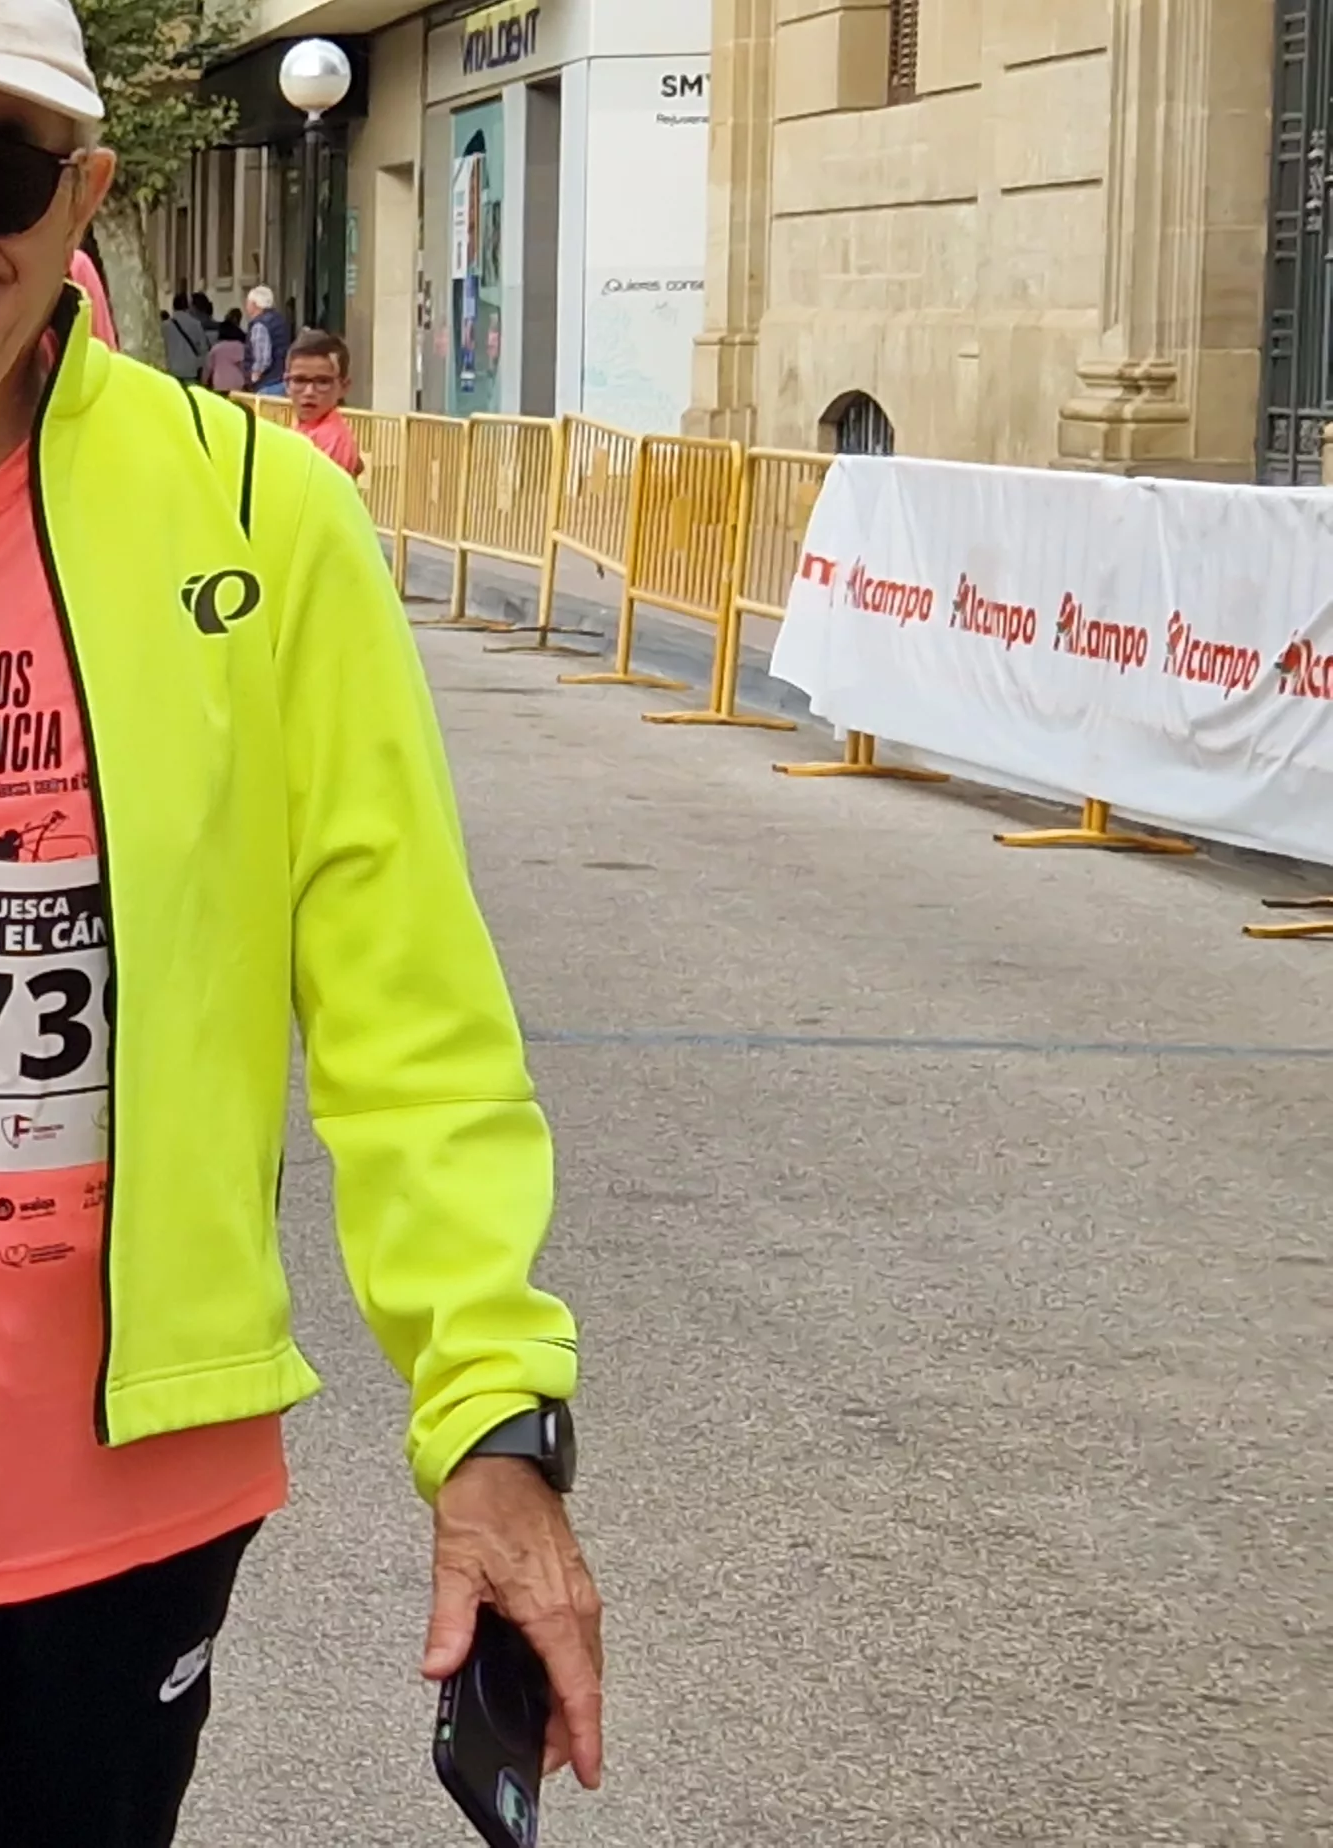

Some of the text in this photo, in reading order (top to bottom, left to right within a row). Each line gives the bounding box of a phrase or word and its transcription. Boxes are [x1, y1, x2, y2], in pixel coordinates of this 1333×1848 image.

[1053, 592, 1148, 675] Alampo
[1163, 609, 1261, 701] Alcampo
[4, 924, 43, 951] EL
[51, 910, 108, 949] CÁN
